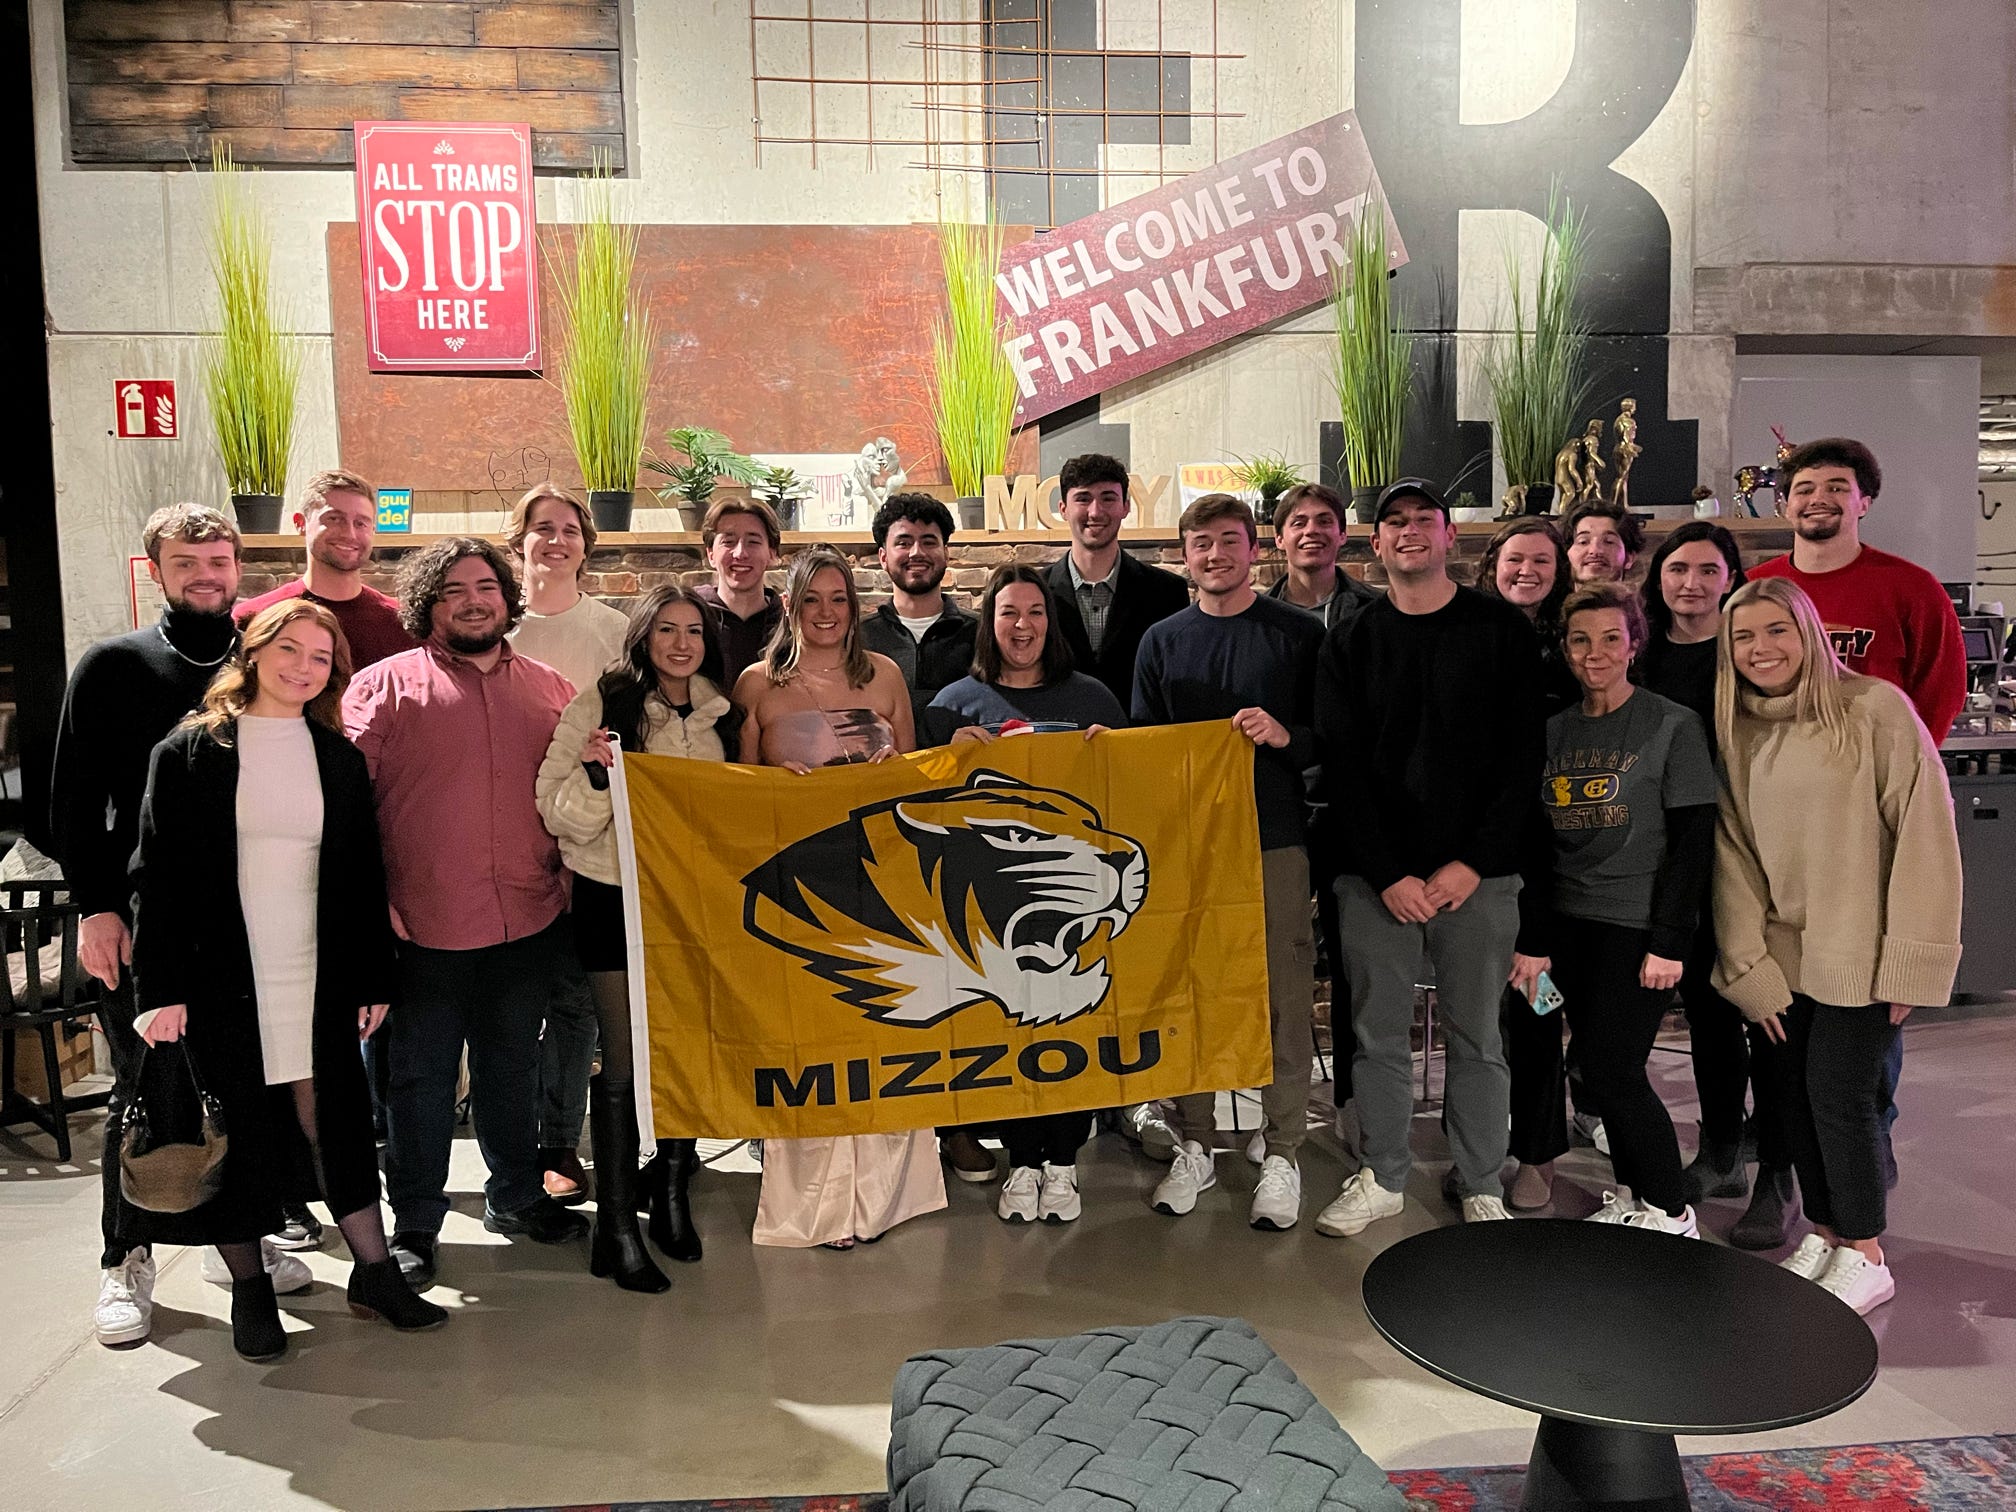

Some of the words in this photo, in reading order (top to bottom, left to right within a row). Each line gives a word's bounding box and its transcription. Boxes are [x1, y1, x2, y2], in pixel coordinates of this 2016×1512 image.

[374, 163, 423, 191] ALL
[432, 163, 518, 192] TRAMS
[374, 199, 522, 292] STOP
[995, 176, 1254, 317] WELCOME
[1252, 146, 1327, 209] TO
[417, 299, 489, 330] HERE
[378, 509, 409, 525] de!
[379, 495, 410, 508] guu
[754, 1029, 1162, 1108] MIZZOU
